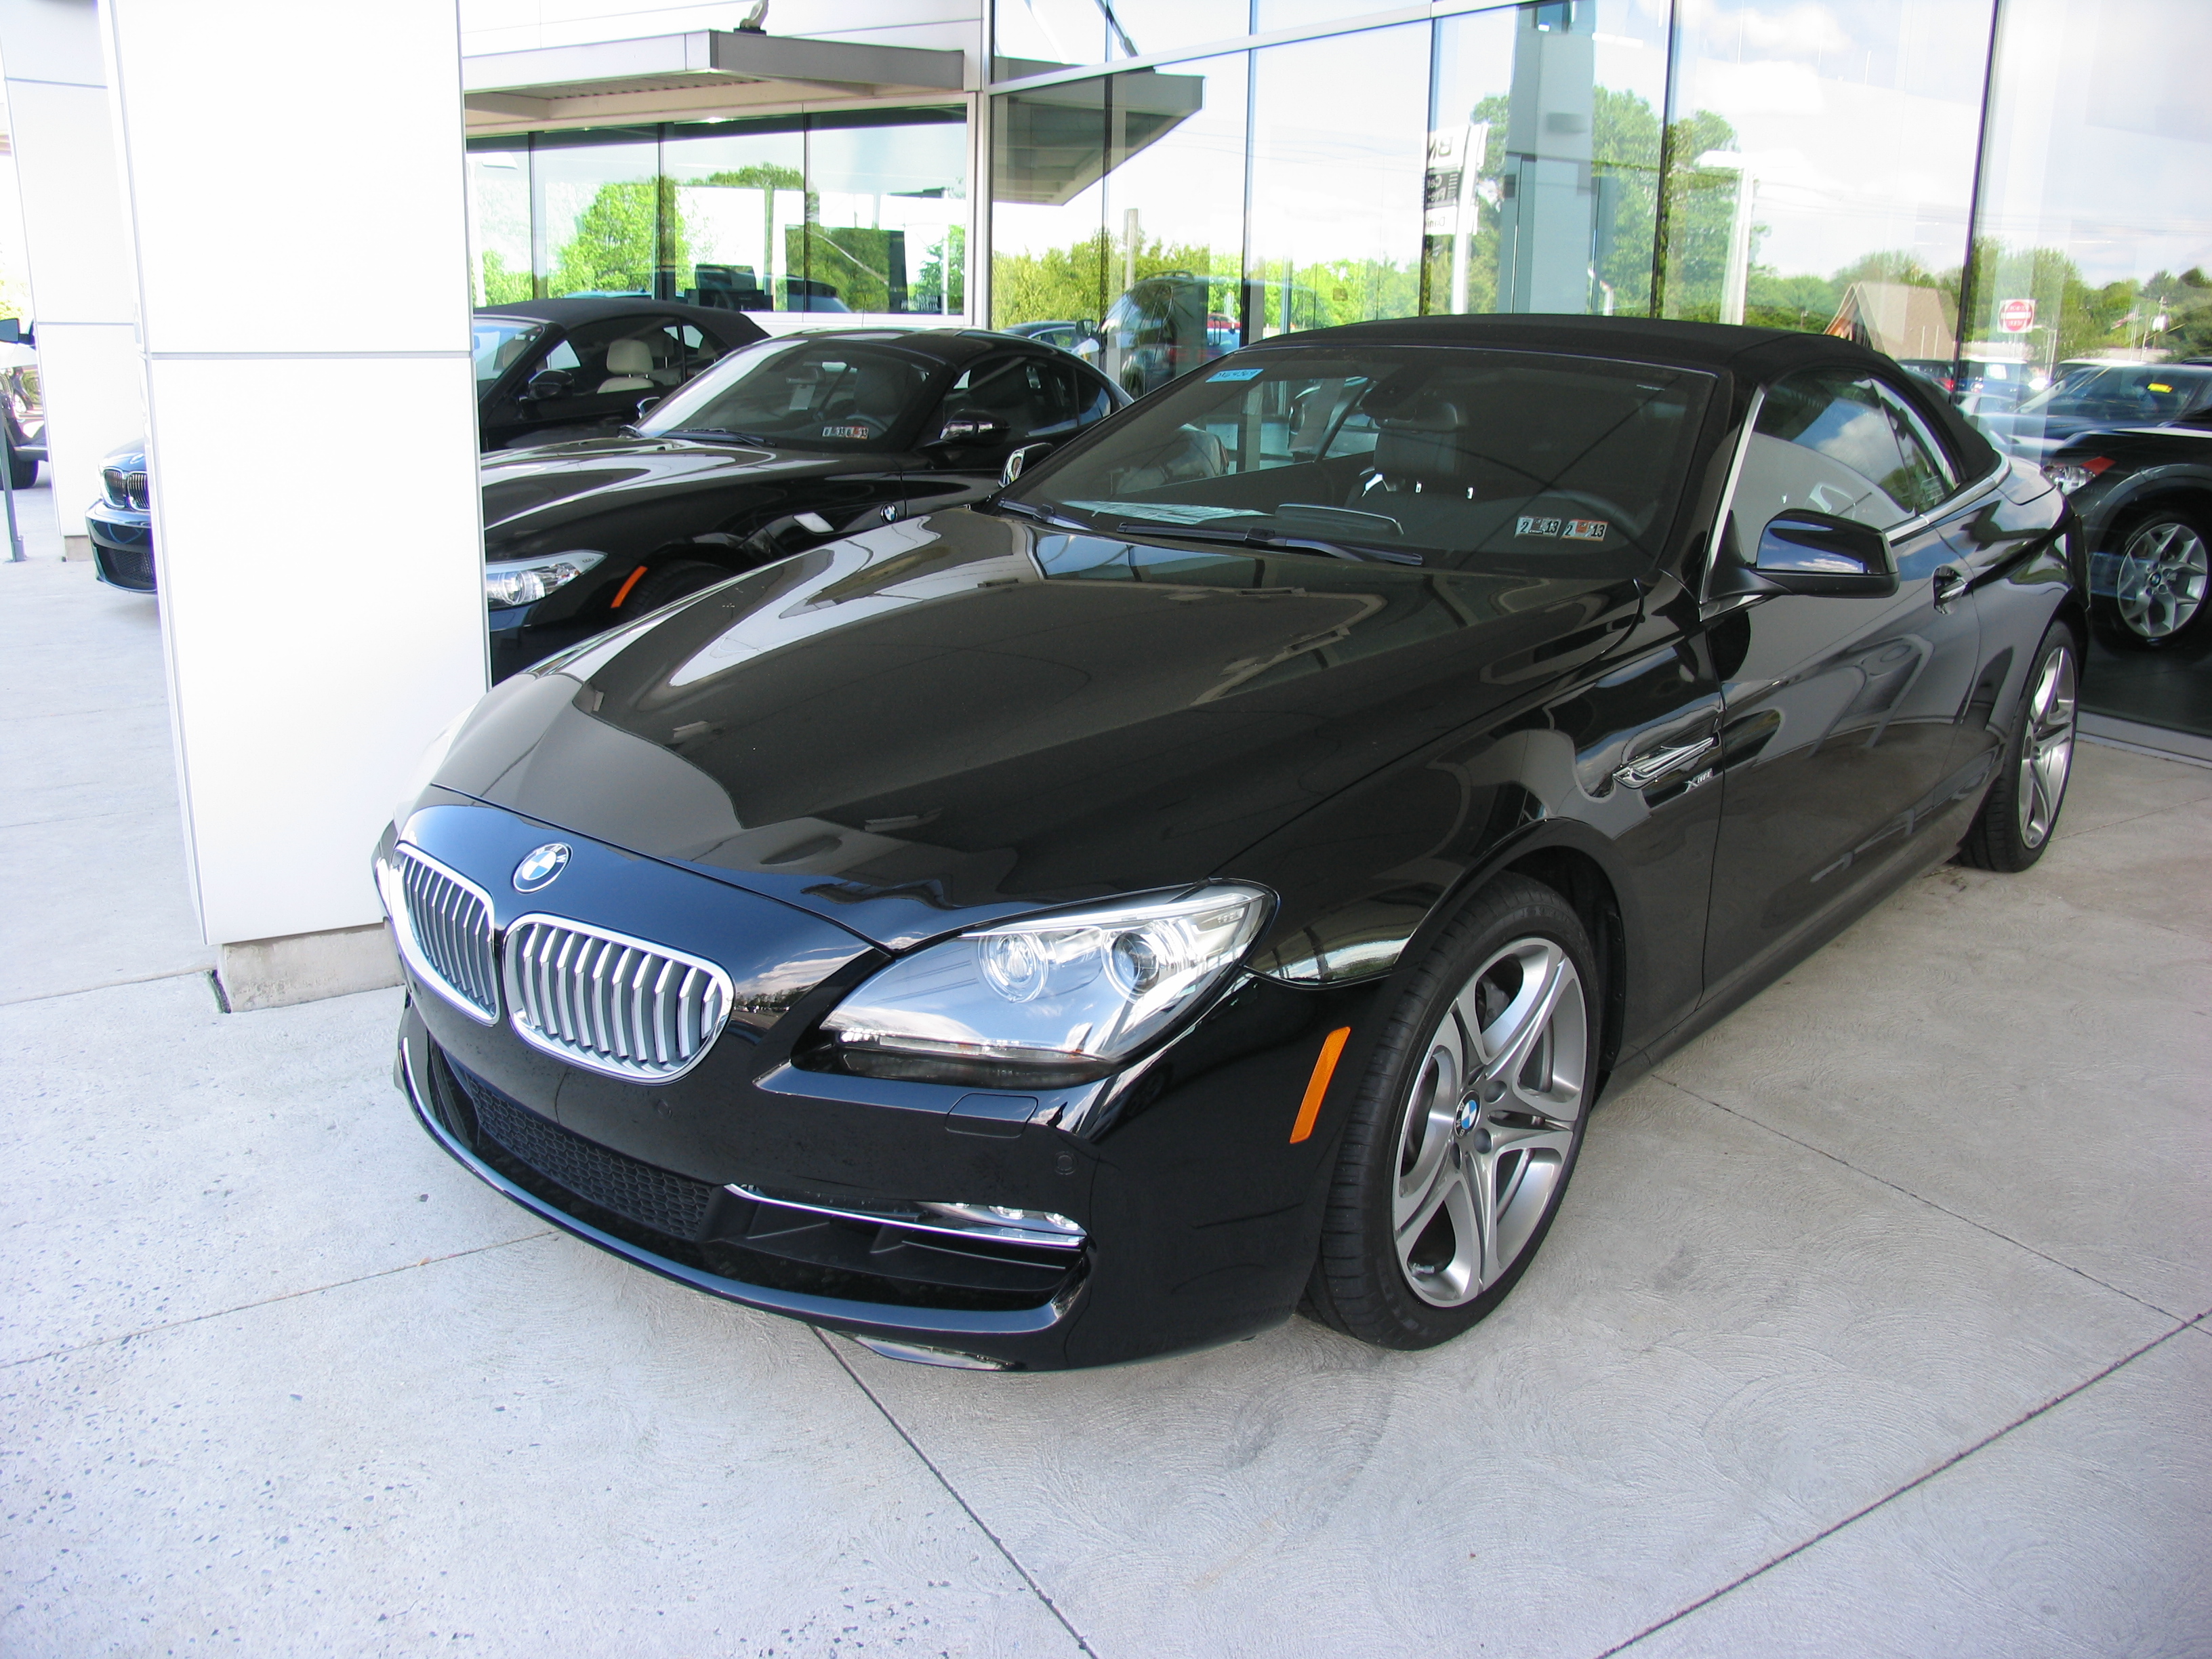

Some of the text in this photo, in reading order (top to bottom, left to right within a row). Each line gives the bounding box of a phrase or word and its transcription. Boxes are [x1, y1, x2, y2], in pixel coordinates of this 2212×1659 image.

[1520, 520, 1559, 533] 2 13
[1564, 524, 1605, 537] 2 13
